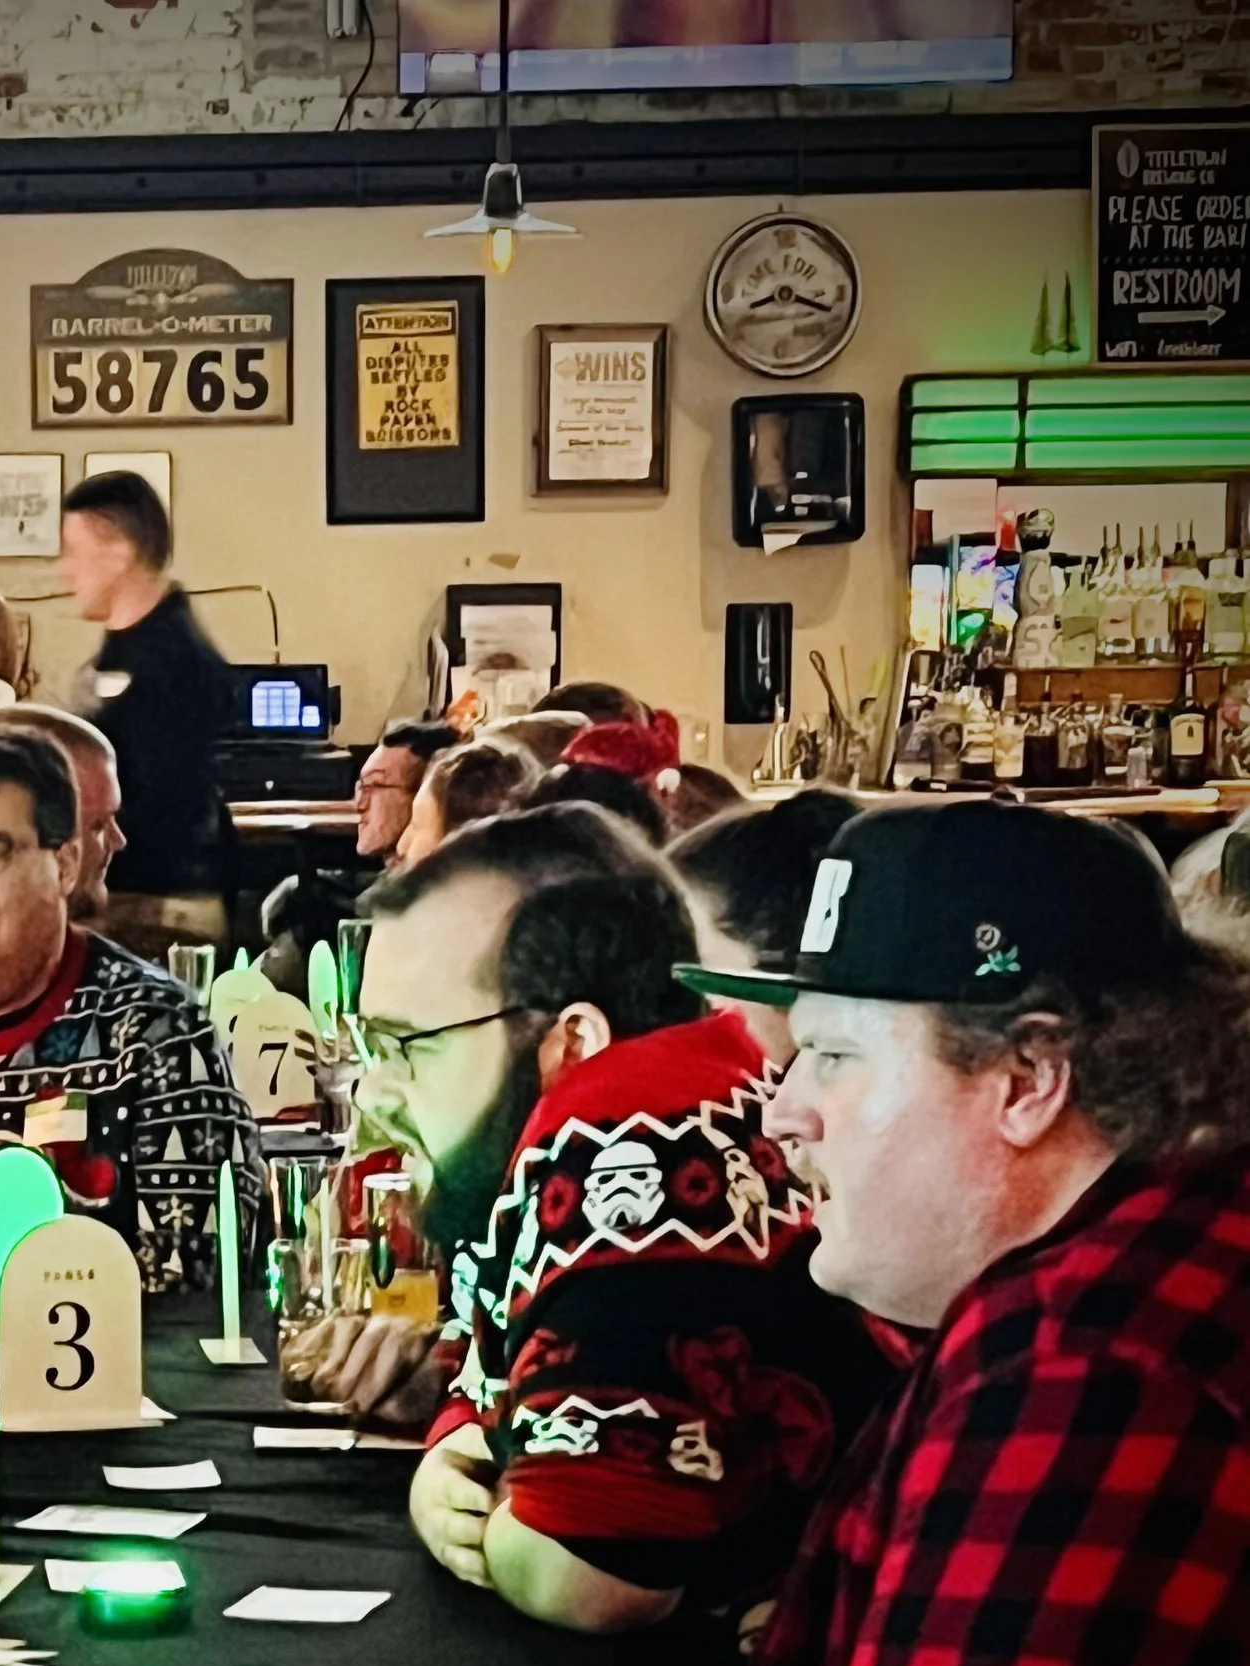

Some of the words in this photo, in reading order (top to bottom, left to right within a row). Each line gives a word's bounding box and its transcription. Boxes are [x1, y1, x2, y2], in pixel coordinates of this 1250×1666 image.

[1108, 195, 1184, 223] PLEASE
[1129, 223, 1153, 250] AT
[1162, 224, 1195, 249] THE
[1113, 267, 1241, 305] RESTROOM
[364, 315, 450, 330] ATTENTION
[391, 341, 423, 354] ALL
[365, 354, 449, 370] DISPUTES
[575, 351, 646, 382] WINS
[52, 348, 269, 414] 58765
[396, 383, 419, 399] BY
[384, 398, 432, 413] ROCK
[379, 413, 437, 428] PAPER
[365, 427, 451, 442] SCISSORS
[258, 1042, 289, 1096] 7
[45, 1301, 95, 1391] 3
